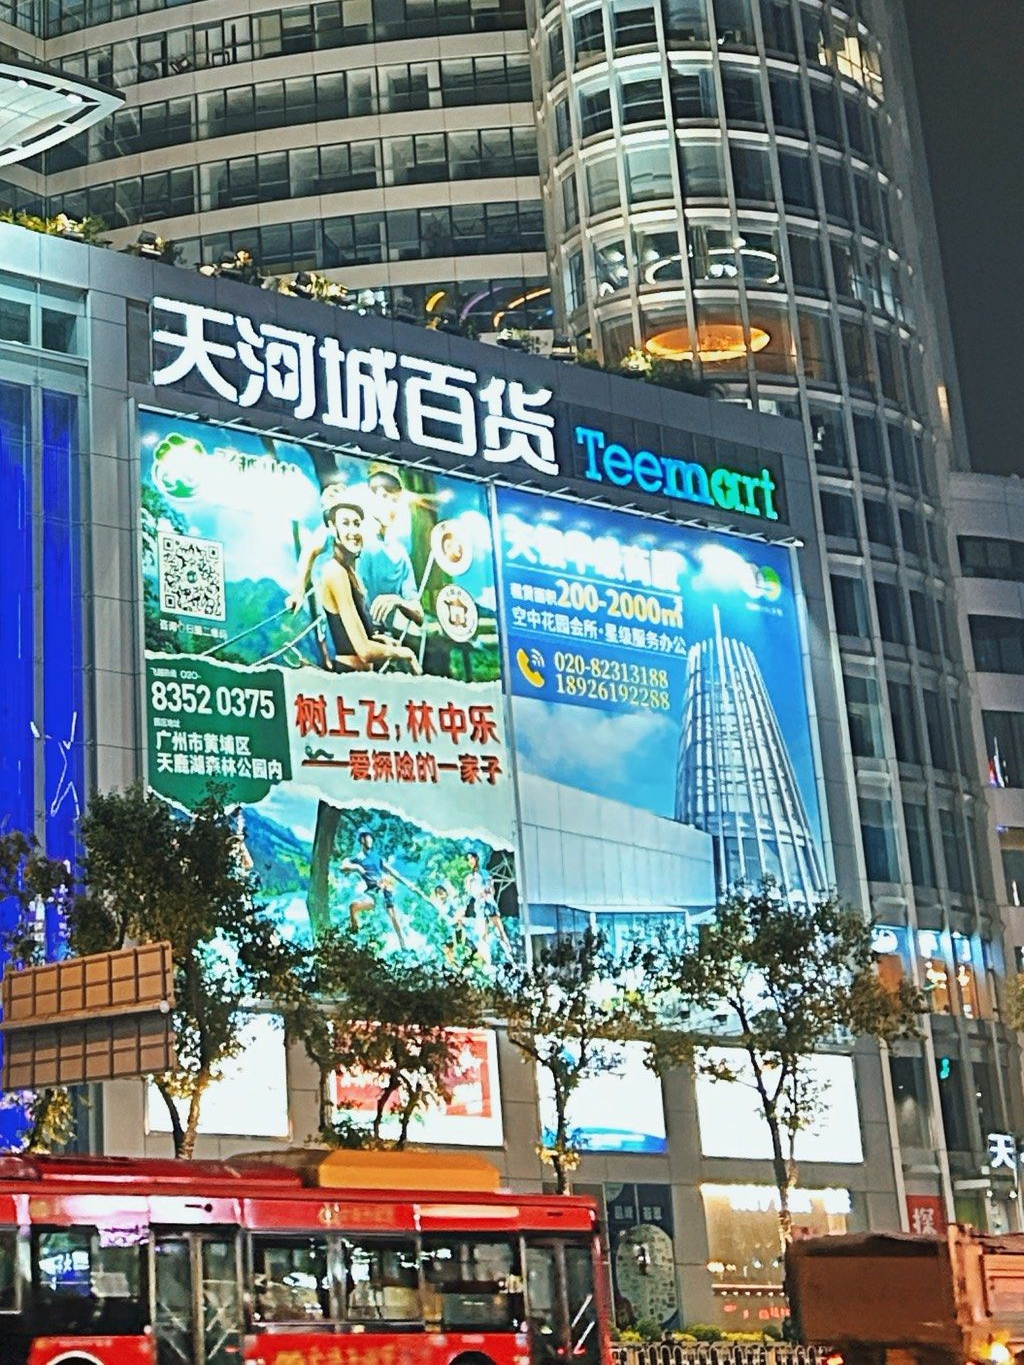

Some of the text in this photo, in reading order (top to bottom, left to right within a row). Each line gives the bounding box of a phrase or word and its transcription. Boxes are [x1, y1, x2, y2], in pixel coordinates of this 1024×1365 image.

[152, 296, 559, 476] 天河城百货
[575, 426, 779, 520] Teemart
[554, 651, 669, 689] 020-82313188
[151, 681, 275, 719] 8352 0375
[556, 673, 670, 710] 18926192288
[156, 730, 251, 756] 广州市黄埔区
[157, 752, 283, 780] 天鹿湖森林公园内
